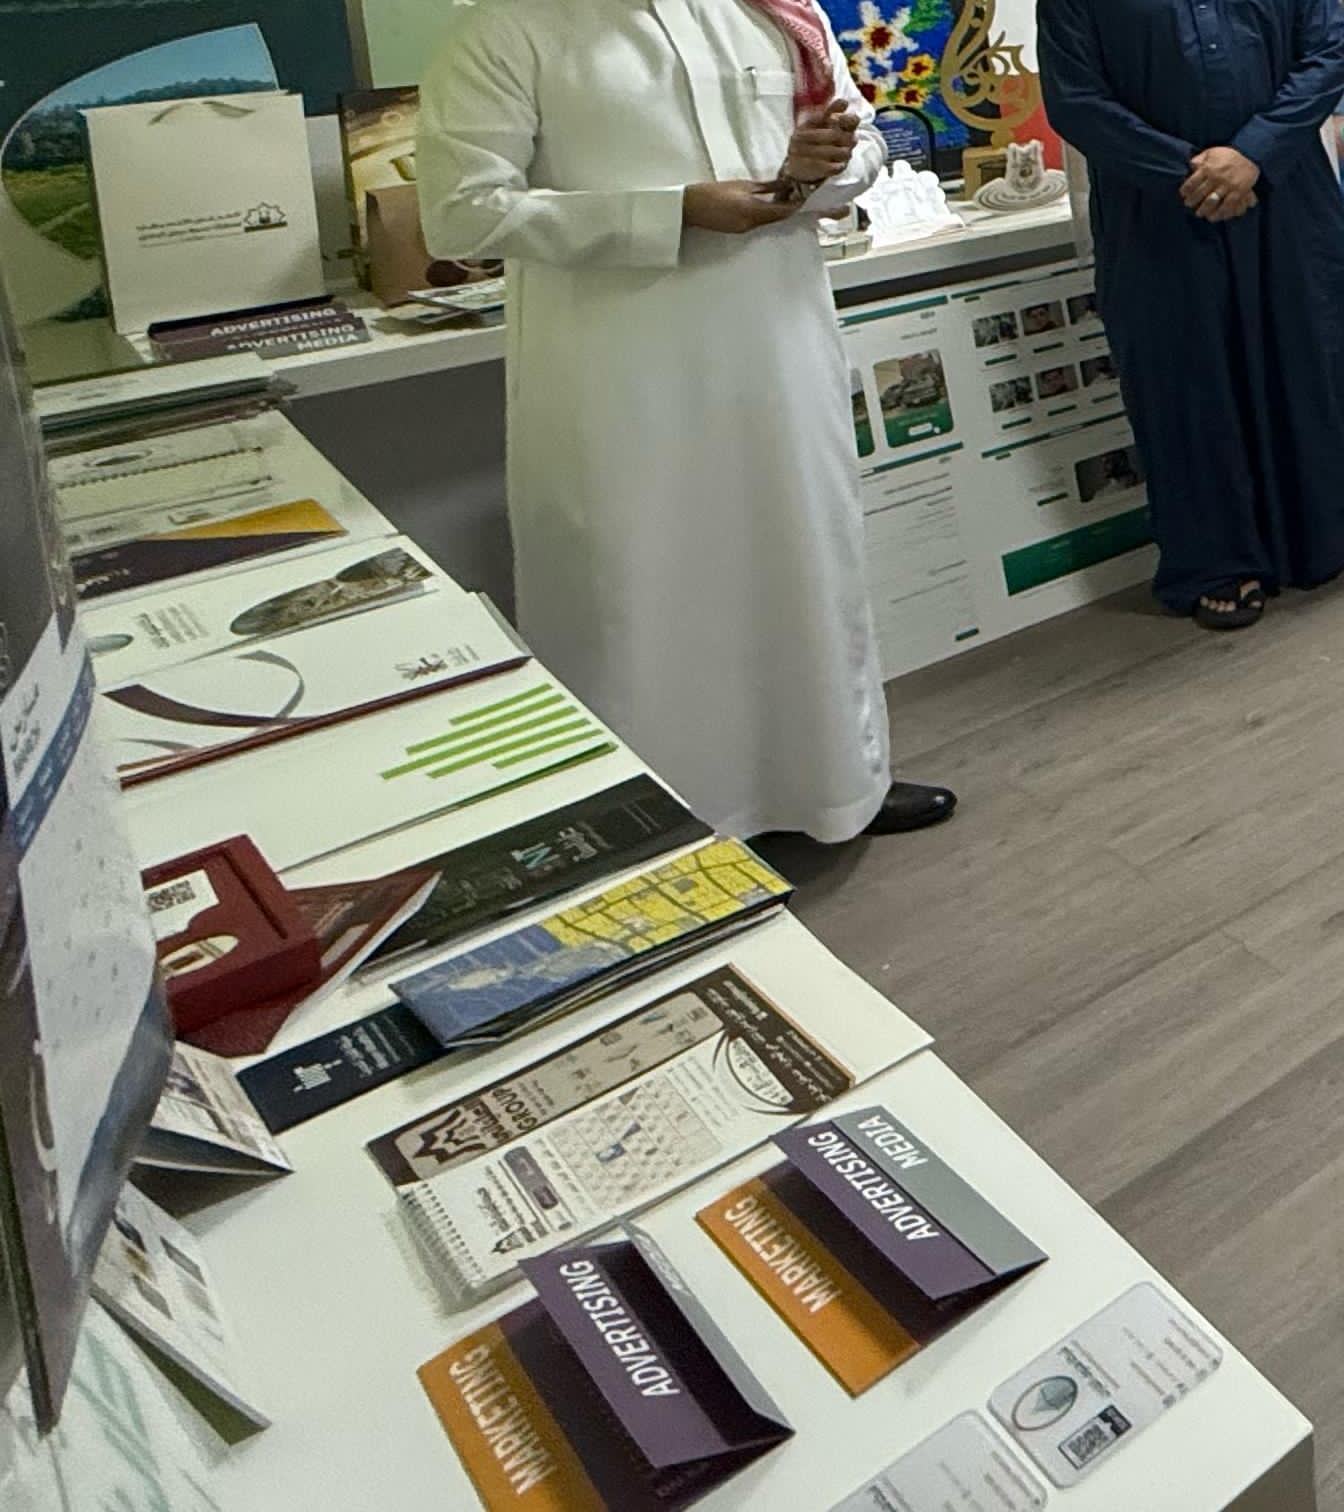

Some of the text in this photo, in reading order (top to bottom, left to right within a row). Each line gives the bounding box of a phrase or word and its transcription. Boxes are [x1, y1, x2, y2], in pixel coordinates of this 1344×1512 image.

[209, 308, 338, 338] ADVERTISING
[297, 334, 361, 351] MEDIA
[492, 1084, 539, 1131] GROUP
[858, 1113, 931, 1170] MEDIA
[806, 1129, 938, 1242] ADVERTISING
[723, 1192, 843, 1314] MARKETING
[559, 1257, 681, 1398] ADVERTISING
[448, 1345, 562, 1496] MARKETING
